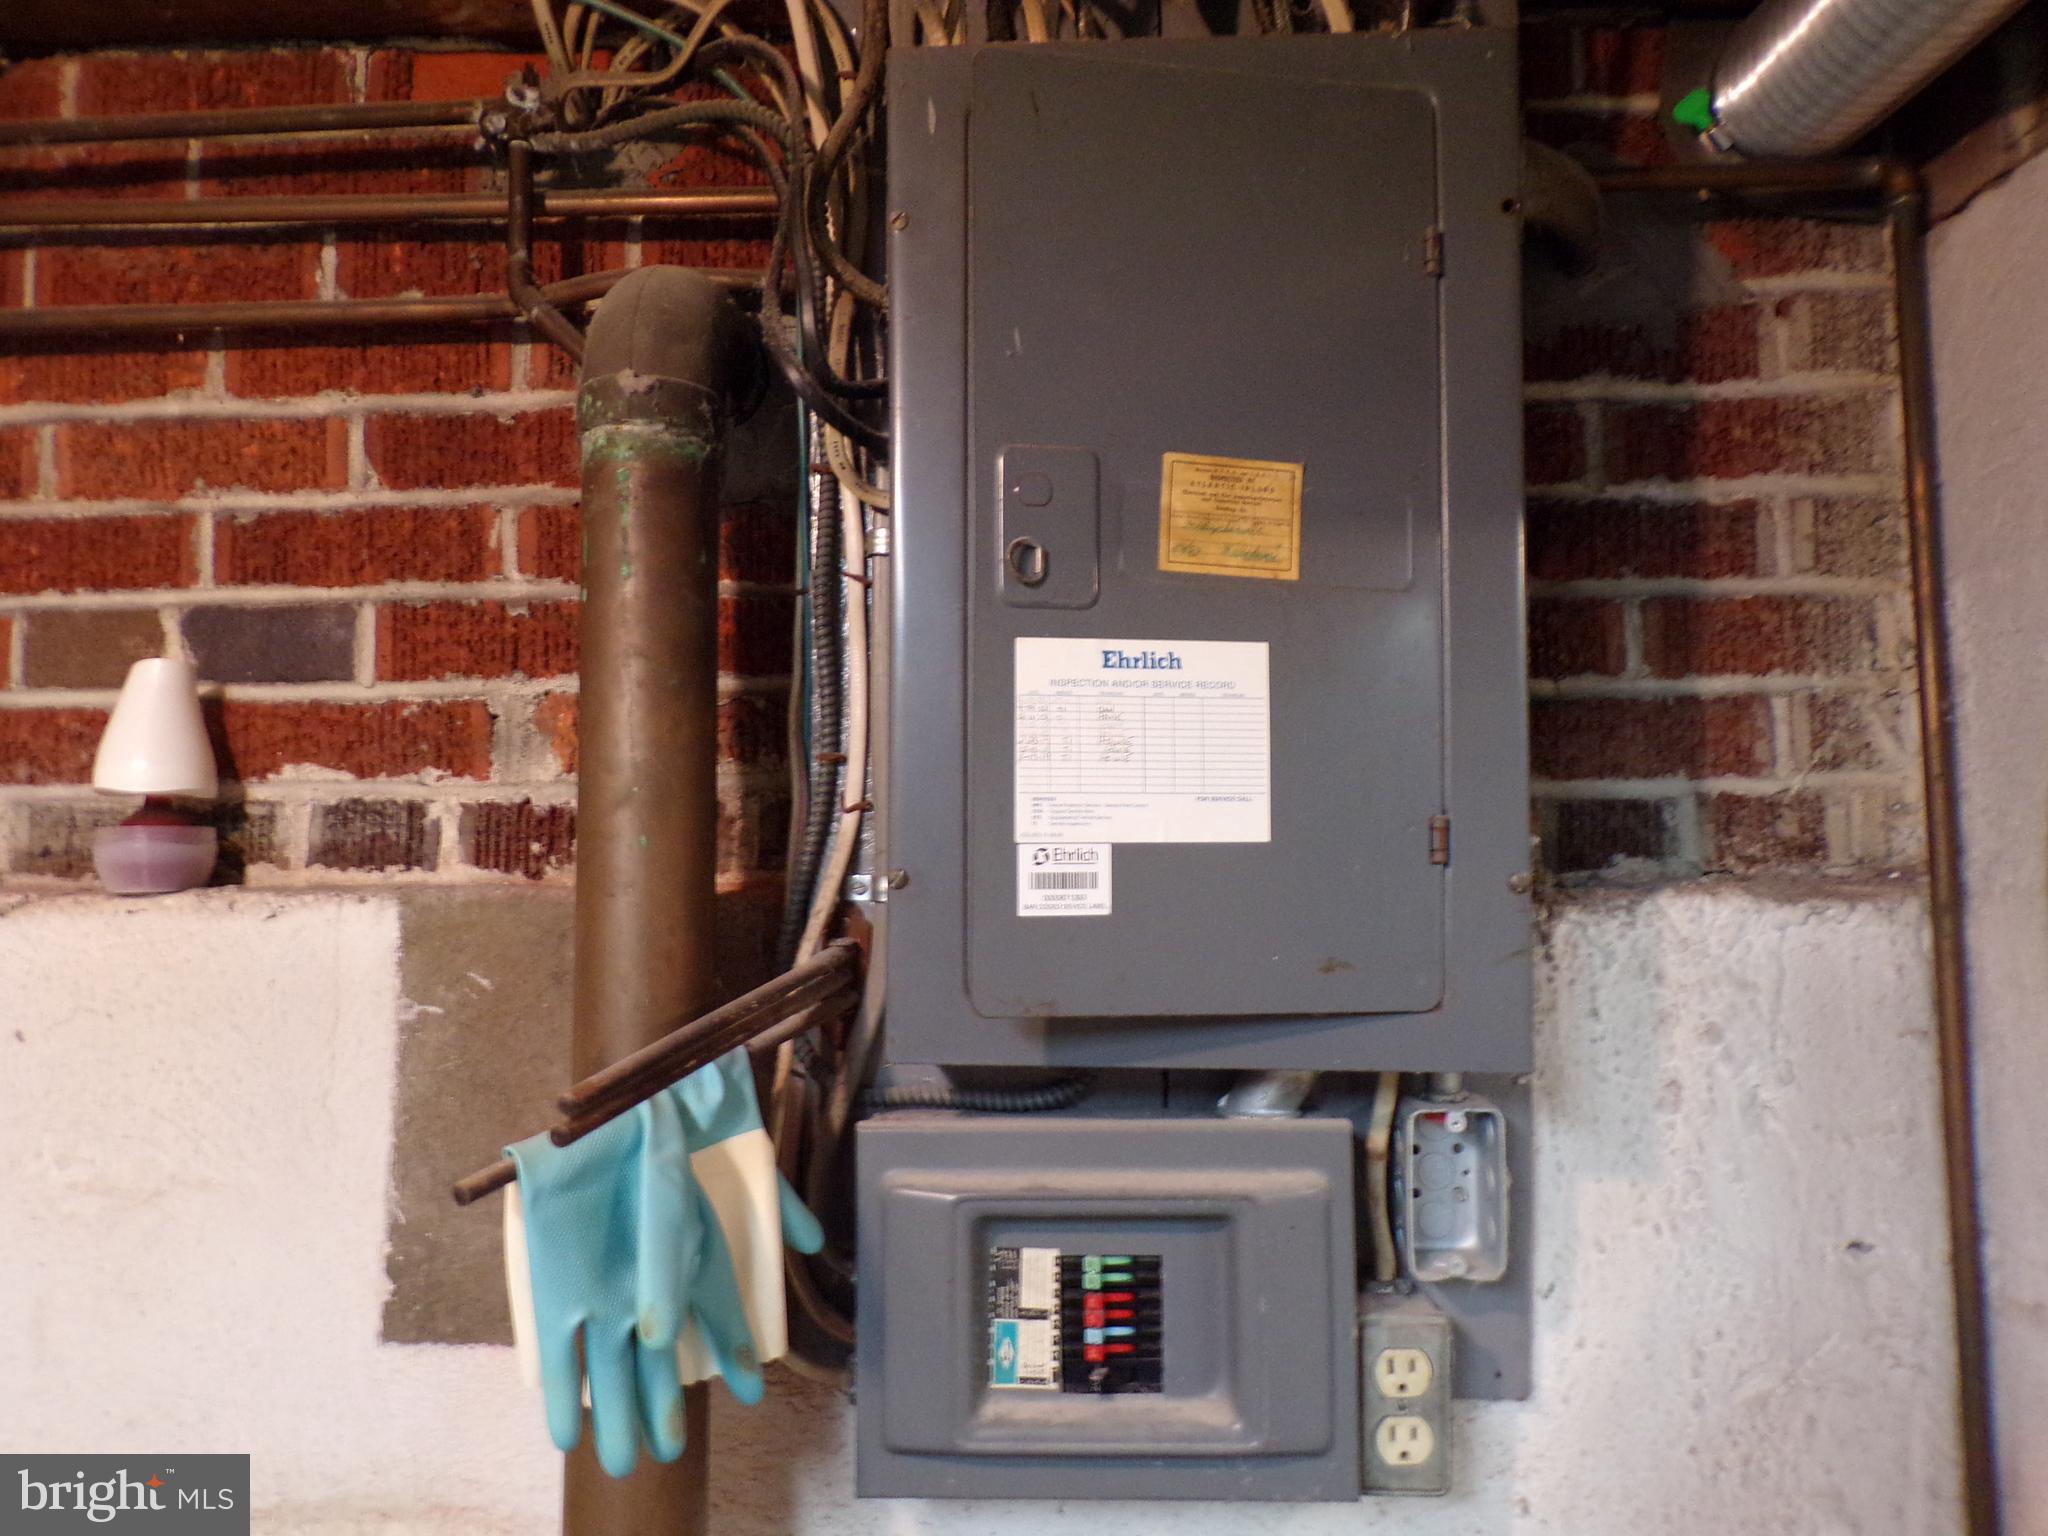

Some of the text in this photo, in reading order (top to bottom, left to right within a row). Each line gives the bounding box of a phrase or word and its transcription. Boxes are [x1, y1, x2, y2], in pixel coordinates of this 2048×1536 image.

[1102, 650, 1182, 670] Ehrlich
[1050, 678, 1109, 688] INSPECTION
[1152, 680, 1193, 690] SERVICE
[1195, 681, 1236, 690] RECORD
[1054, 847, 1098, 861] Ehrlich
